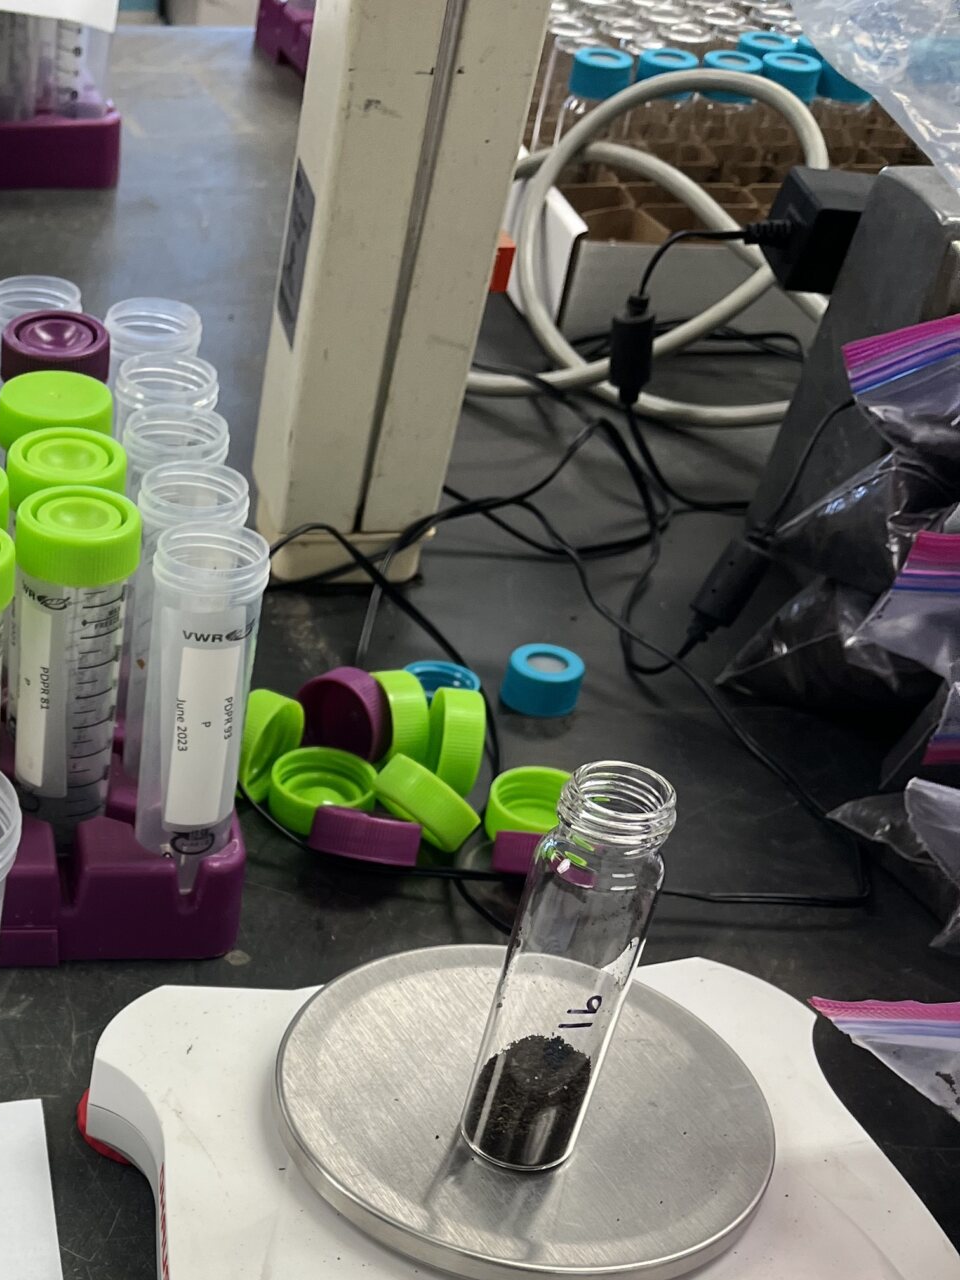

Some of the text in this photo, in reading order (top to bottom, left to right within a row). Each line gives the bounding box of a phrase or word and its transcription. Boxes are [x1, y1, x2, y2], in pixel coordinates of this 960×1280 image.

[182, 629, 224, 644] VWR
[40, 666, 51, 697] PDPR
[176, 697, 188, 753] June 2023
